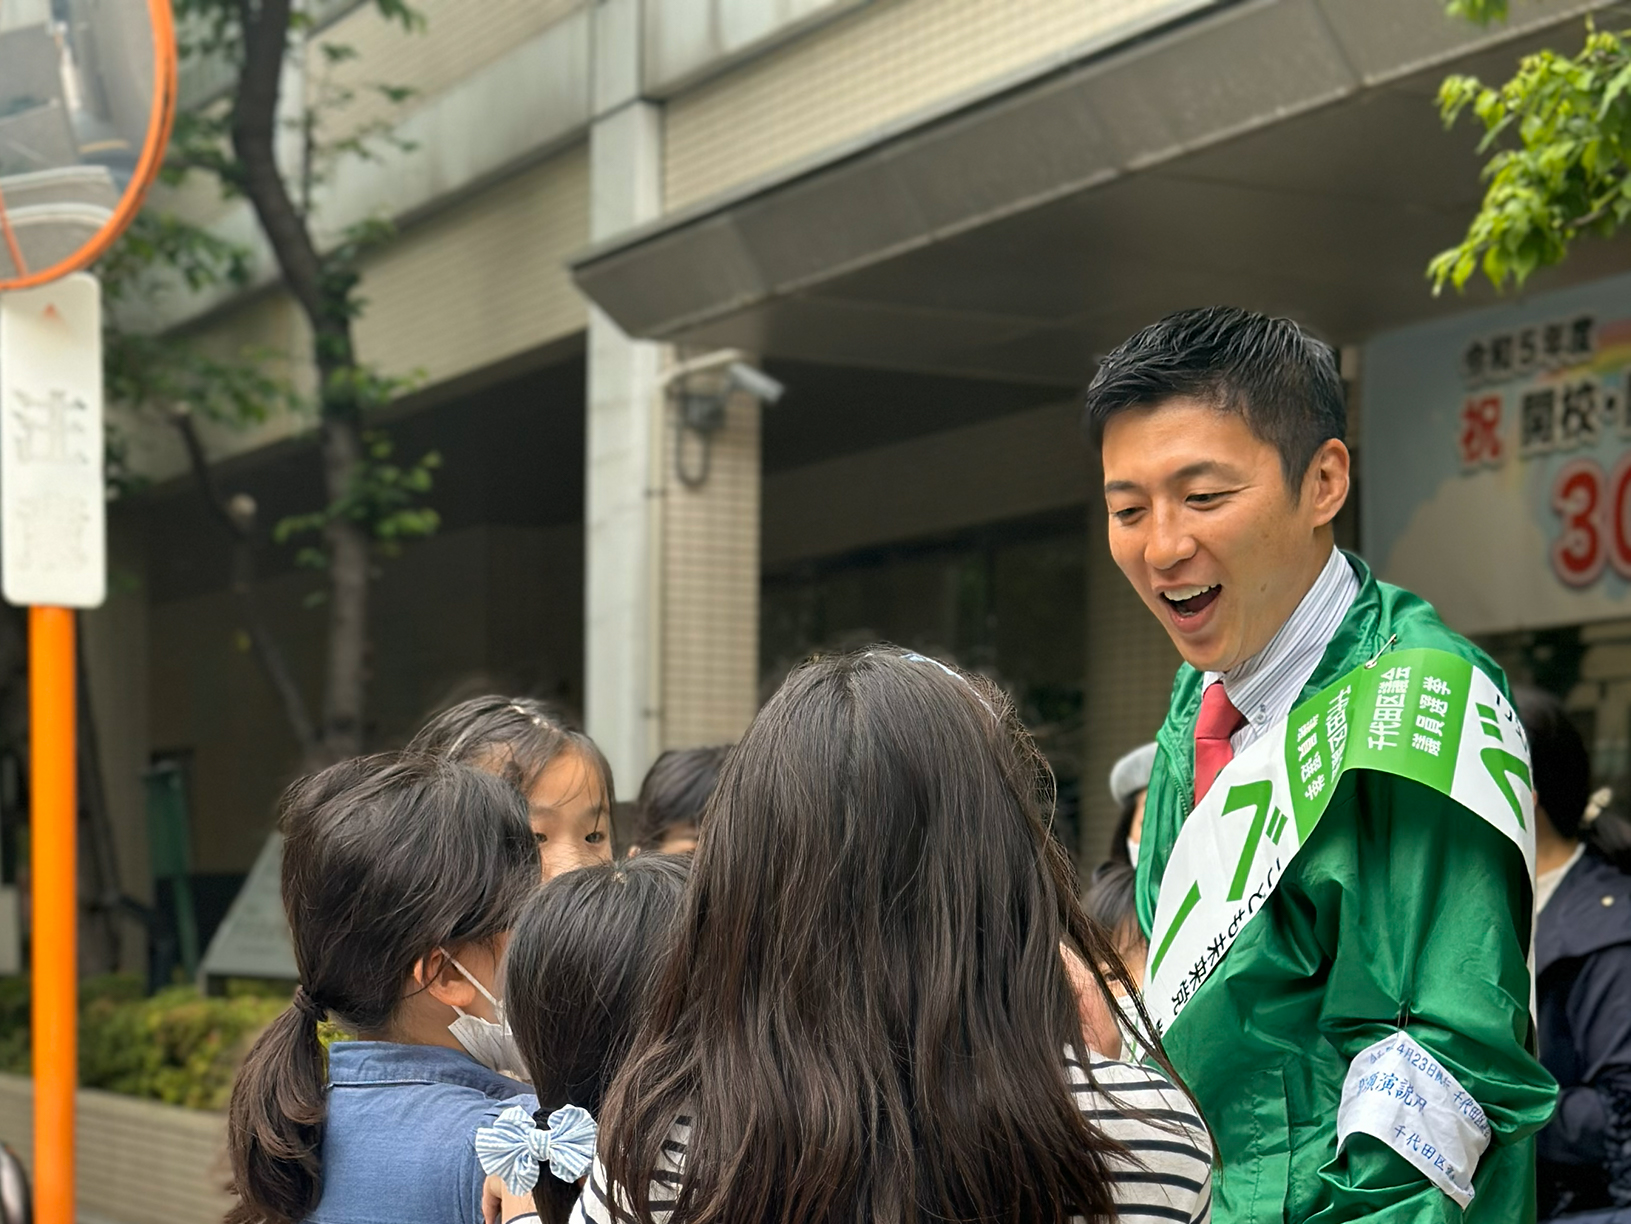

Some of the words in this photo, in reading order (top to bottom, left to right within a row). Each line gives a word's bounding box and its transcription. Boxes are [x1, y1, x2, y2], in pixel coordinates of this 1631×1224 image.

[1462, 393, 1502, 464] 祝
[1522, 373, 1631, 447] 開校・
[1367, 666, 1412, 751] 千代田区議会
[1411, 675, 1452, 757] 議員選挙
[1296, 713, 1326, 801] 議員選挙
[1171, 856, 1281, 1016] こども未来党
